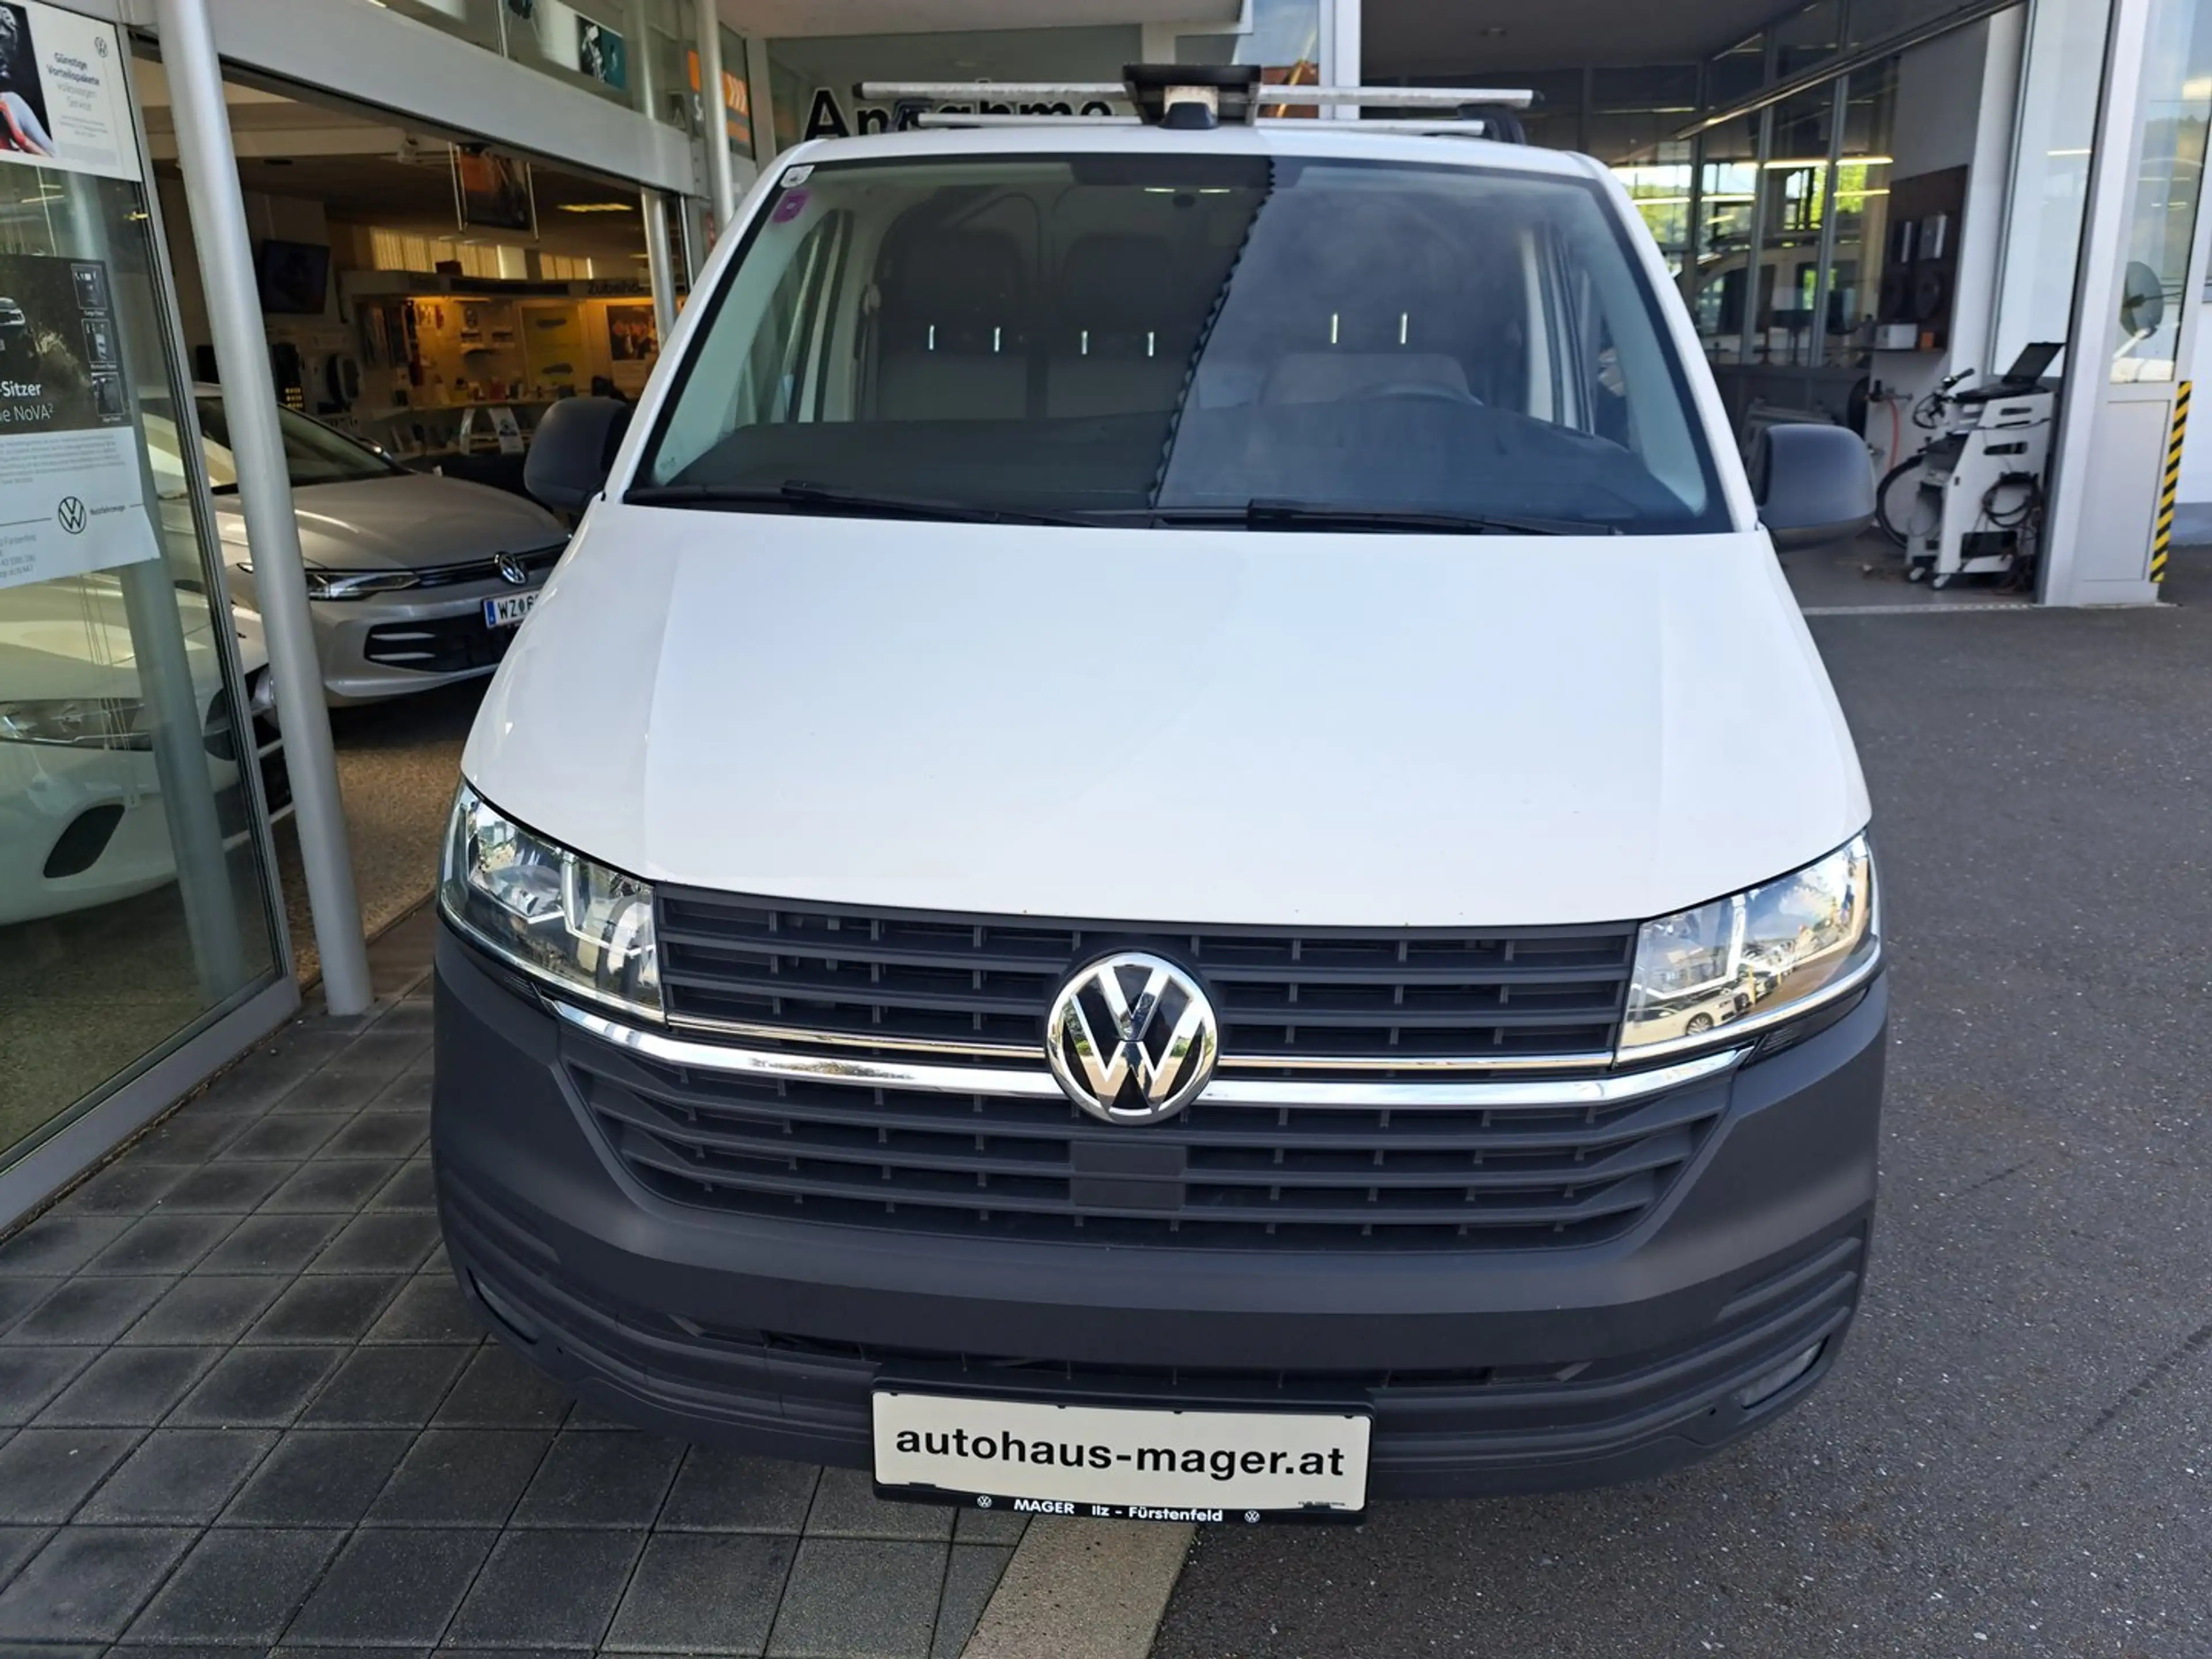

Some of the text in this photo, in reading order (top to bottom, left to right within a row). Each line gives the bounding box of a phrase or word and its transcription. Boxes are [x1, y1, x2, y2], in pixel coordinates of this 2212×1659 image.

[896, 1428, 1345, 1481] autohaus-mager.at
[1014, 1499, 1075, 1515] MAGER
[1128, 1506, 1224, 1522] Fürstenfeld
